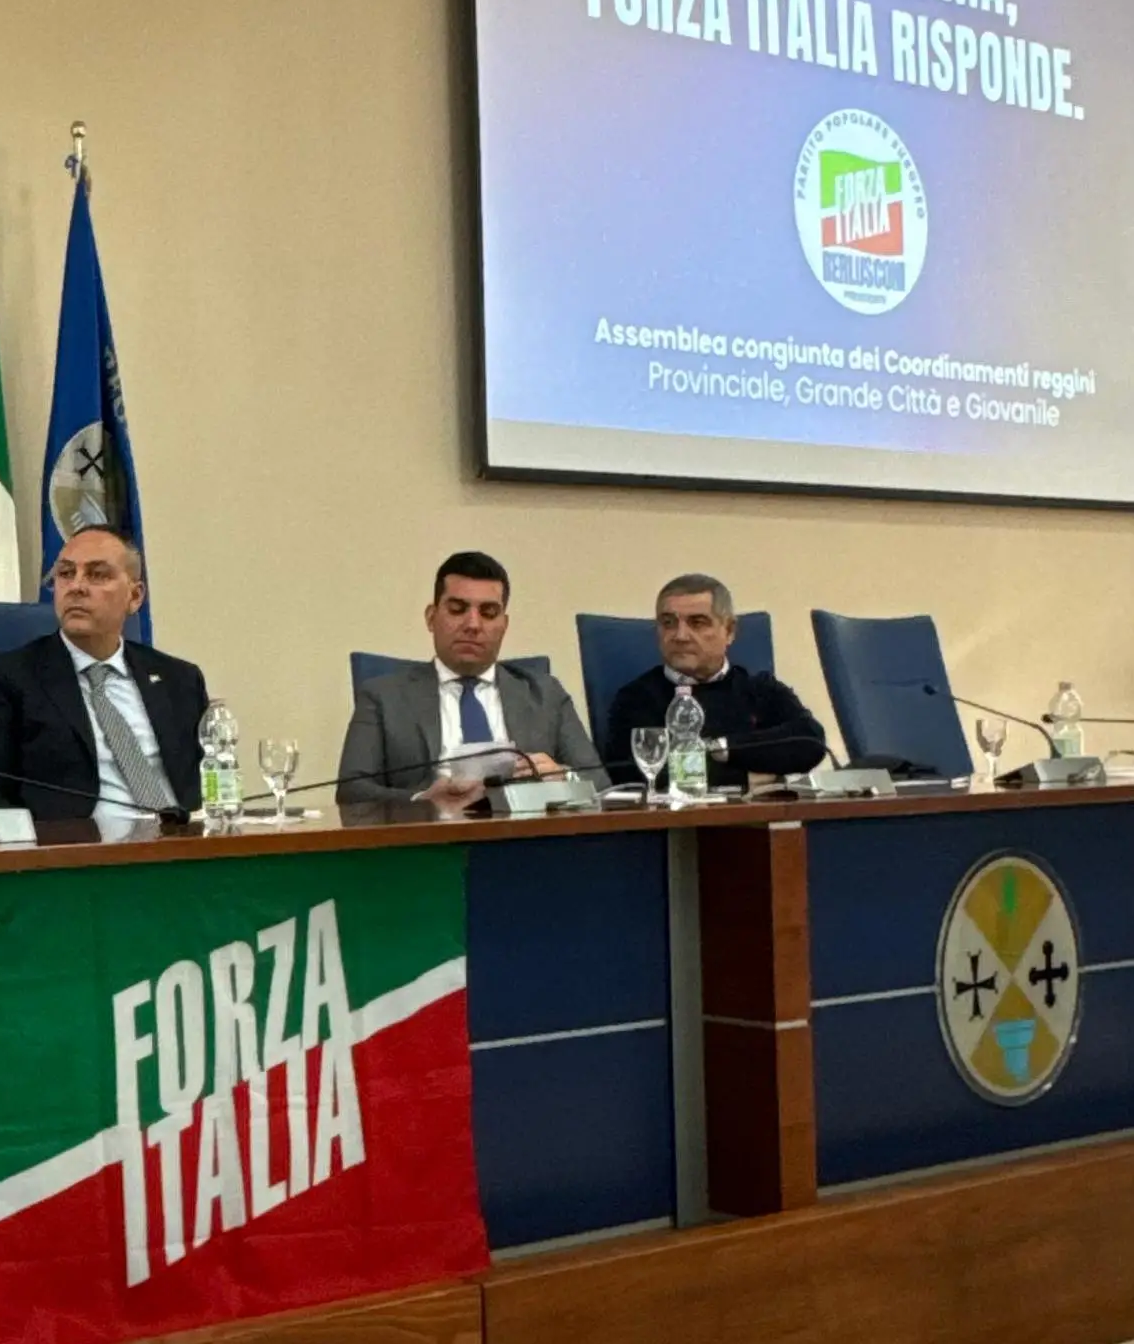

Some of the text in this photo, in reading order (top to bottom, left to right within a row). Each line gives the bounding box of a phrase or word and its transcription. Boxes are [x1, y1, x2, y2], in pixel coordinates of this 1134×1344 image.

[891, 9, 1085, 121] RISPONDE.
[834, 165, 886, 212] FORZA
[835, 197, 891, 245] ITALIA
[594, 317, 1096, 399] Assemblea congiunta dei Coordinamenti reggini
[648, 360, 1060, 428] Provinciale, Grande Città e Giovanile
[112, 898, 352, 1126] FORZA
[121, 1041, 366, 1288] ITALIA
